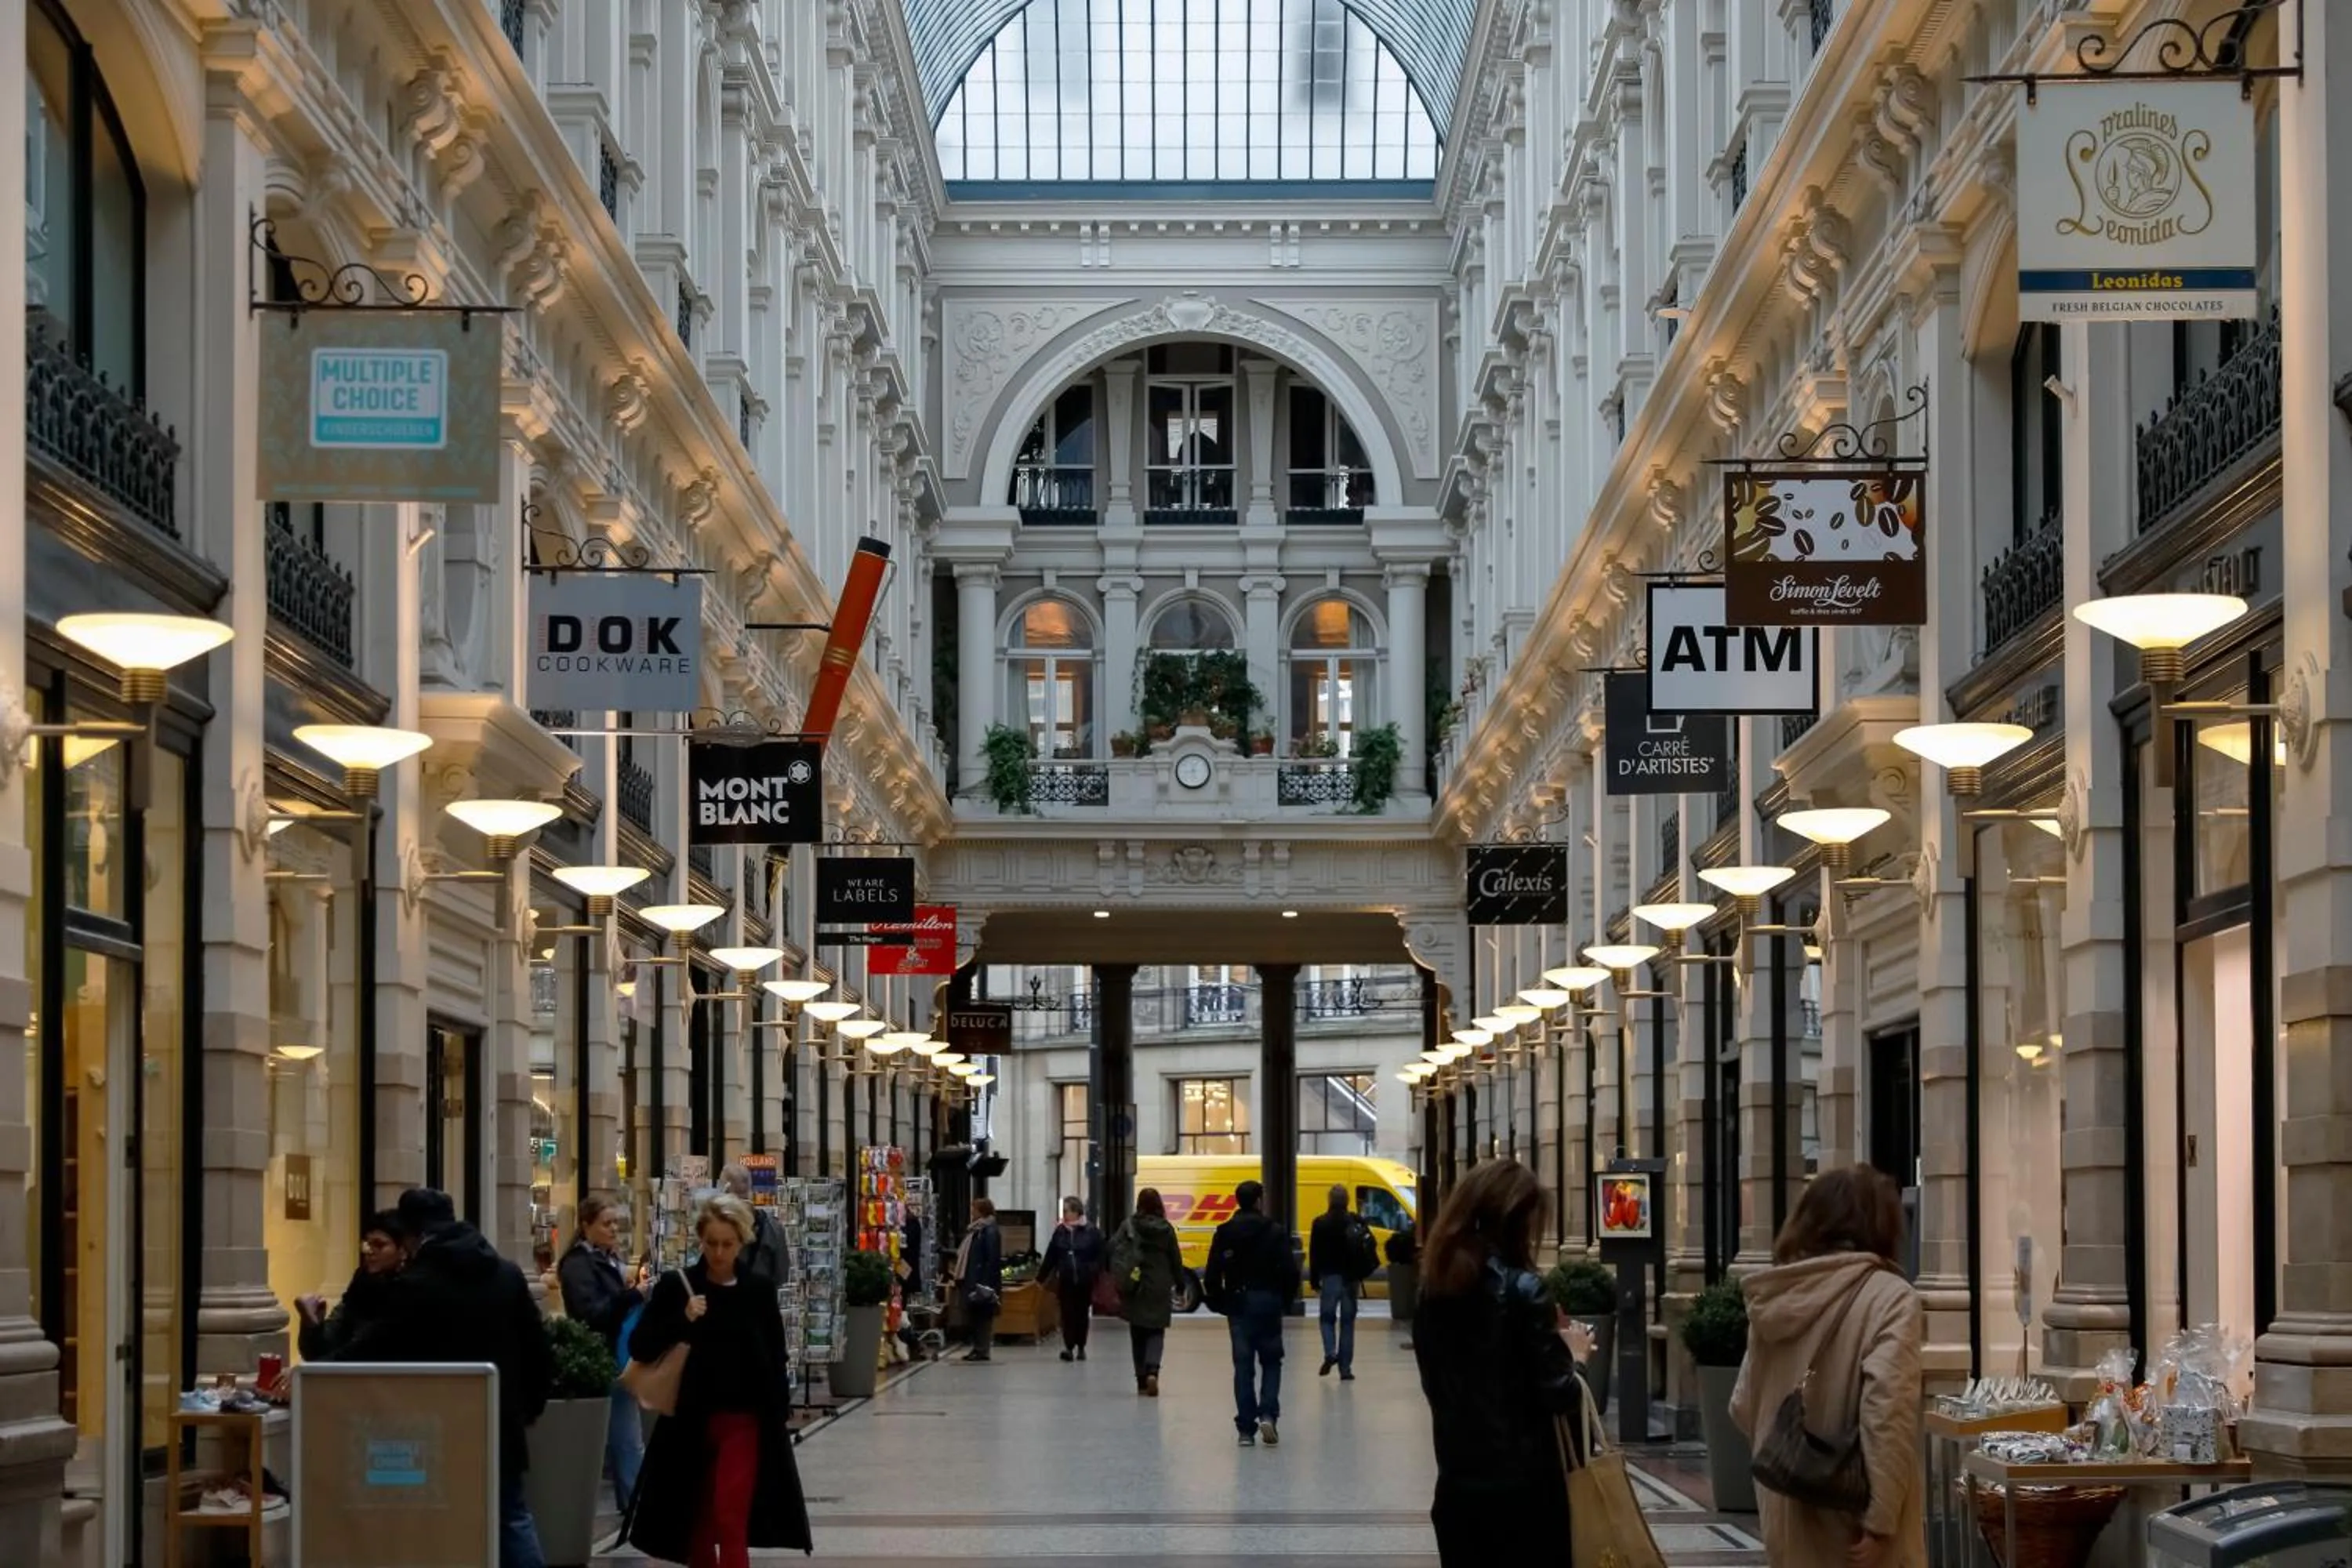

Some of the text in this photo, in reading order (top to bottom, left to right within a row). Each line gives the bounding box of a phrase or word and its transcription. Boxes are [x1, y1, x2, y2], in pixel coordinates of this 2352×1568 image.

[2100, 101, 2177, 143] pralines
[2092, 272, 2183, 289] Leonidas
[2052, 300, 2223, 312] FRESH BELGIAN CHOCOLATES
[321, 359, 431, 384] MULTIPLE
[333, 387, 419, 411] CHOICE
[1769, 575, 1831, 601] Simon
[548, 615, 682, 655] DOK
[1661, 626, 1802, 672] ATM
[538, 655, 691, 673] COOKWARE
[1638, 736, 1690, 757] CARRÉ
[699, 777, 788, 800] MONT
[700, 801, 789, 825] BLANC
[1479, 868, 1552, 897] Calexis
[833, 888, 898, 902] LABELS
[950, 1011, 1007, 1028] DELUCA
[739, 1156, 775, 1167] HOLLAND
[1160, 1194, 1236, 1221] DH
